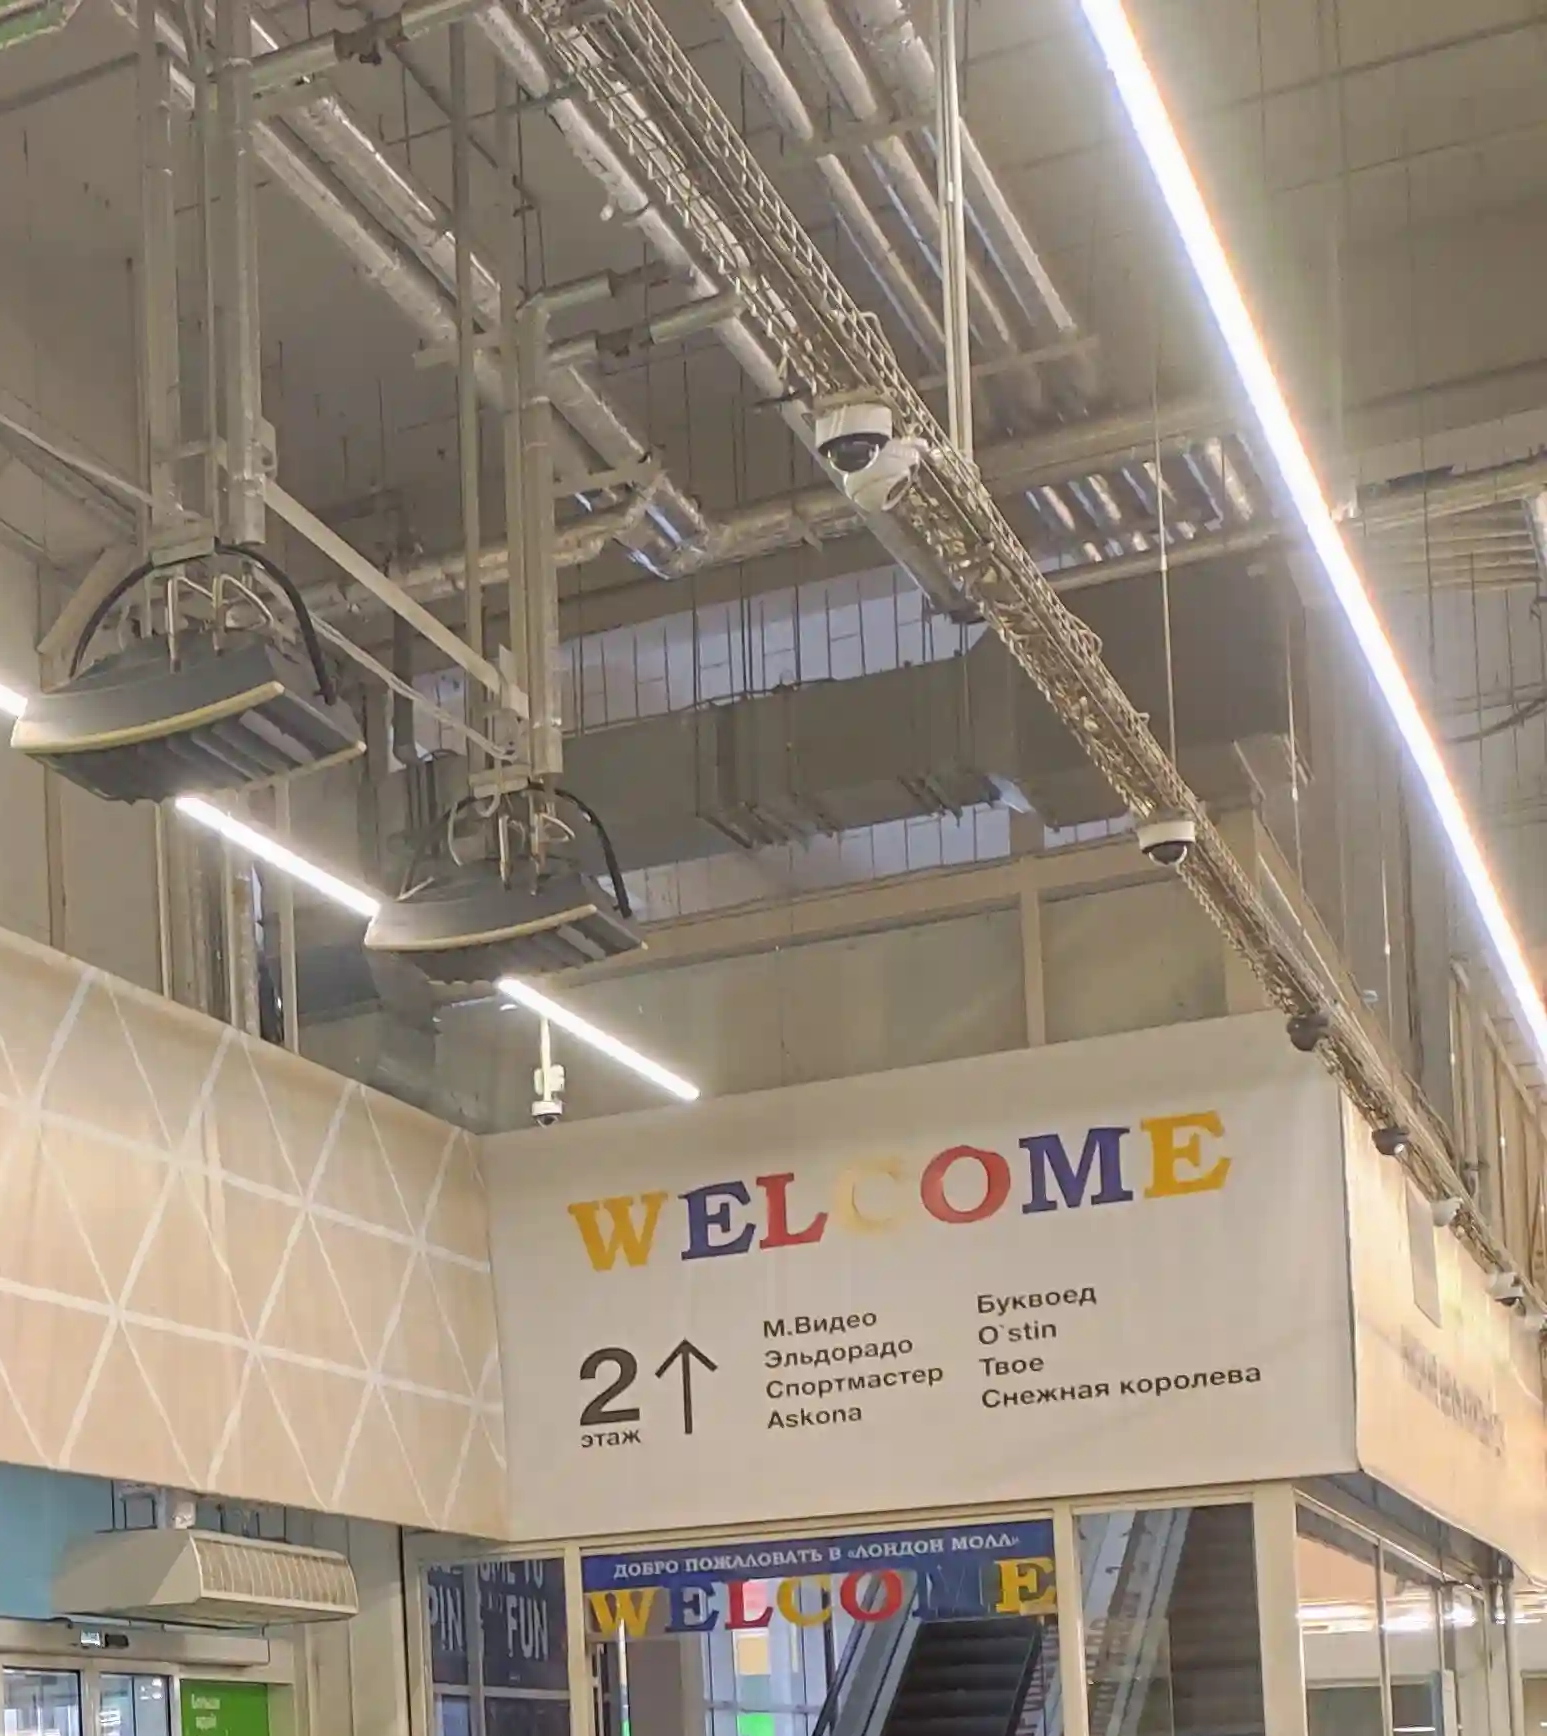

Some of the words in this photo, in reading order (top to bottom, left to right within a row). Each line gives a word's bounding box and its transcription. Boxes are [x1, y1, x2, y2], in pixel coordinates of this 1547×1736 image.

[567, 1110, 1231, 1272] WELCOME
[977, 1284, 1097, 1316] Буквоед
[763, 1308, 878, 1338] М.Видео
[764, 1336, 913, 1370] Эльдорадо
[979, 1354, 1044, 1378] Твое
[579, 1347, 641, 1426] 2
[766, 1365, 944, 1400] Спортмастер
[981, 1381, 1109, 1410] Снежная
[1120, 1363, 1262, 1396] королева
[767, 1403, 862, 1430] Askona
[580, 1428, 642, 1448] этаж
[613, 1559, 678, 1579] ДОБРО
[685, 1547, 822, 1573] ПОЖАЛОВАТЬ
[829, 1546, 841, 1561] В
[507, 1595, 548, 1661] FUN
